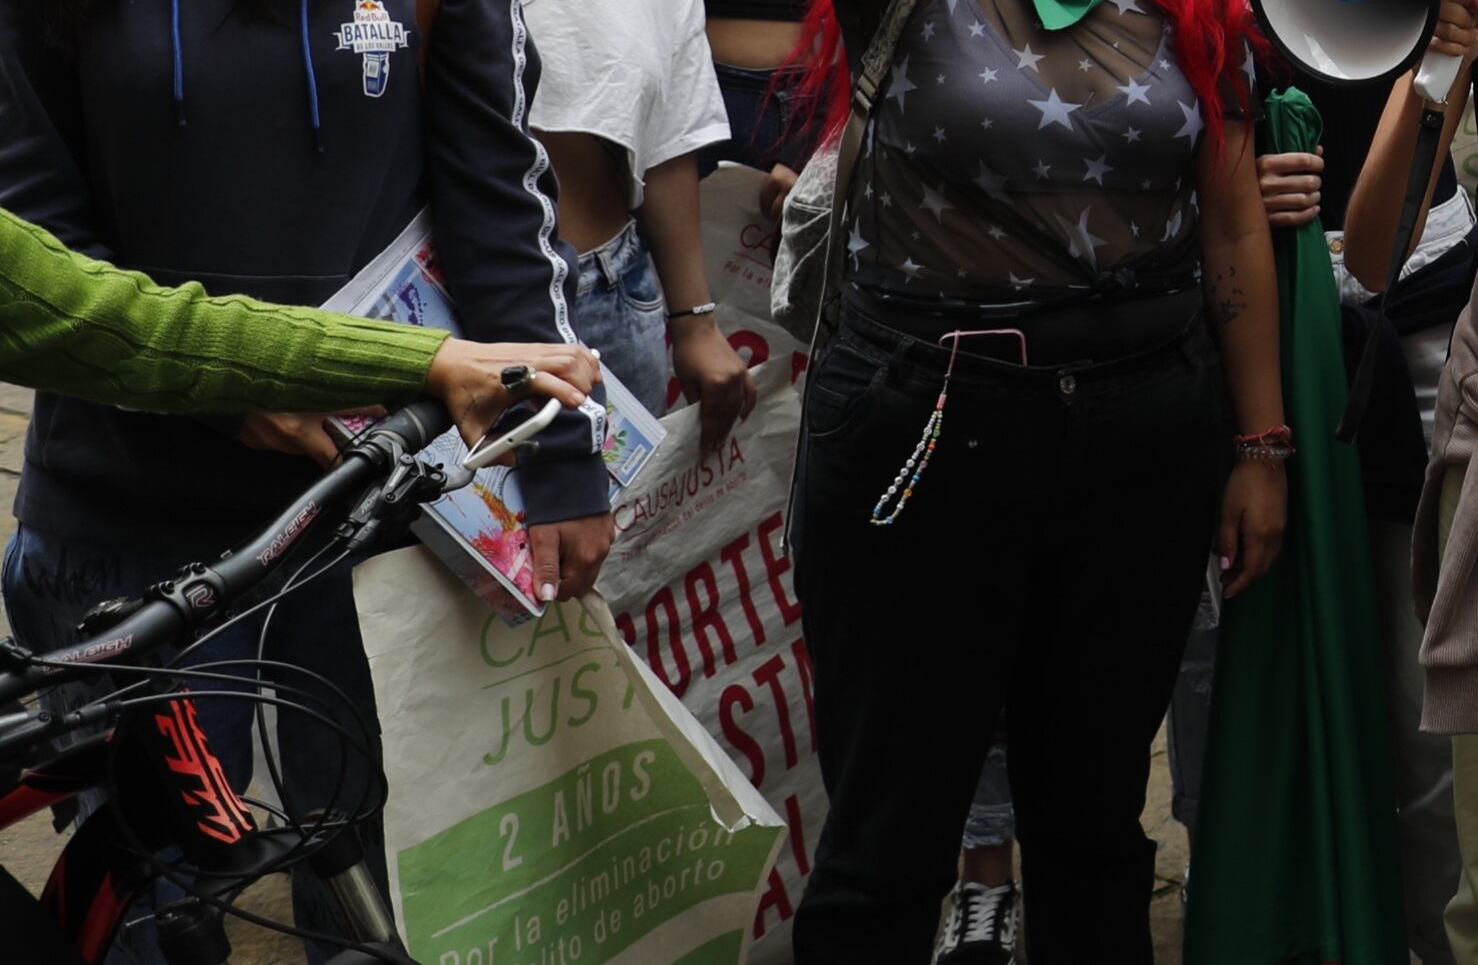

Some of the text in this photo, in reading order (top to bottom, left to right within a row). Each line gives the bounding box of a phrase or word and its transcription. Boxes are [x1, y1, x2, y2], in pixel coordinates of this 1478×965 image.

[343, 24, 402, 43] BATALLA
[257, 500, 318, 567] RALEIGH
[500, 751, 656, 872] 2 AÑOS
[515, 915, 541, 952] la
[556, 820, 736, 925] eliminación
[594, 909, 622, 944] de
[633, 859, 726, 919] aborto
